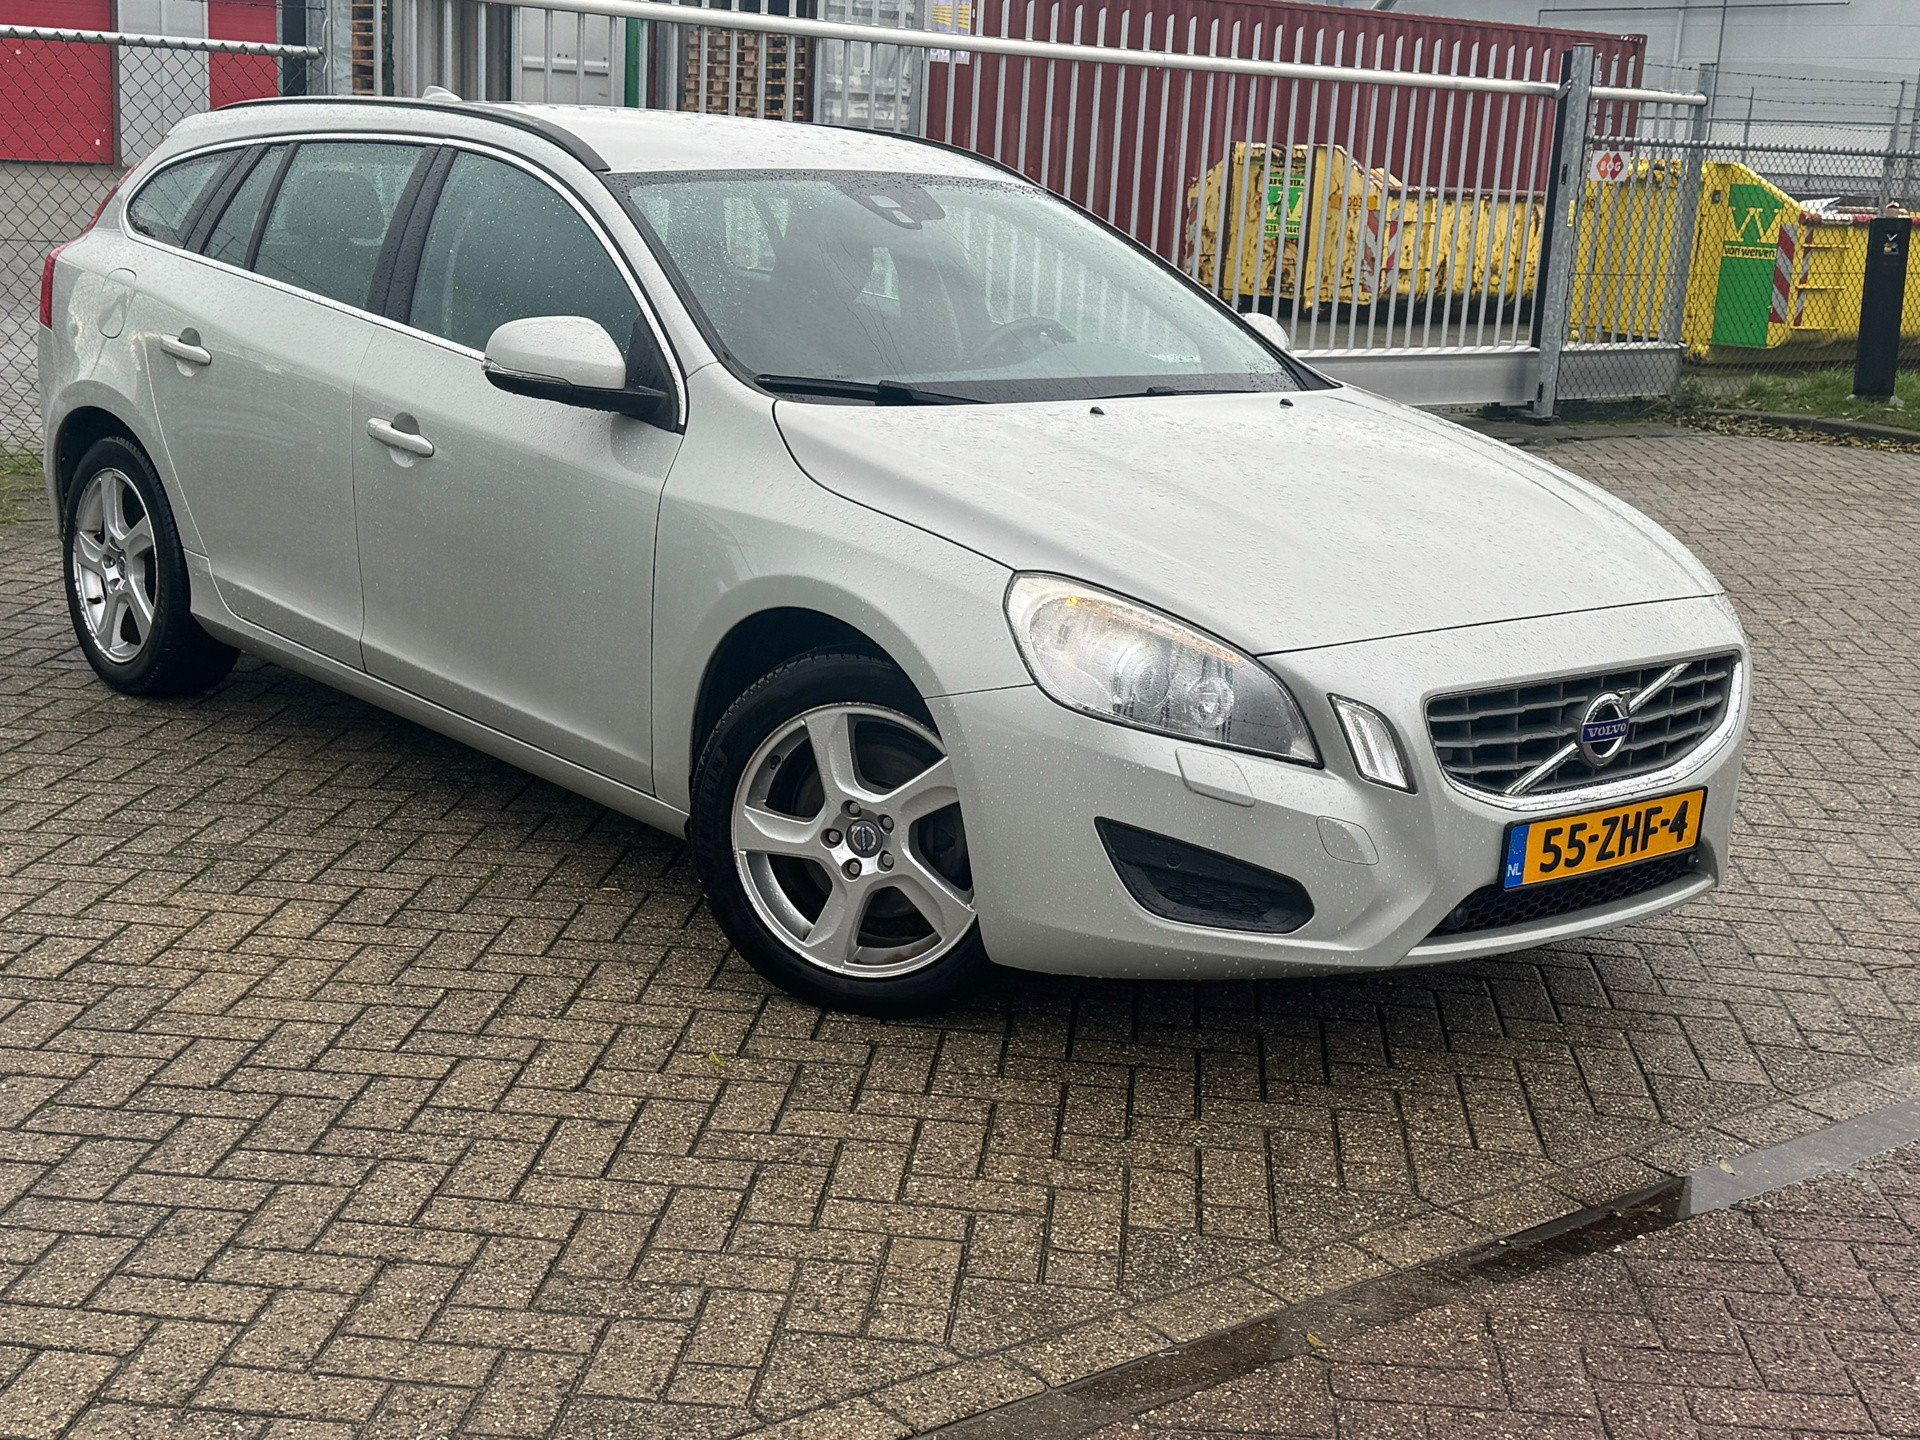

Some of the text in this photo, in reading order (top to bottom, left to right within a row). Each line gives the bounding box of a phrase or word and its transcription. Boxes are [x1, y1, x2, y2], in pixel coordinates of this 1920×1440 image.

[1741, 247, 1775, 258] werven
[1587, 723, 1627, 737] VOLVO
[1539, 800, 1689, 873] 55-ZHF-4
[1507, 864, 1521, 877] NL
